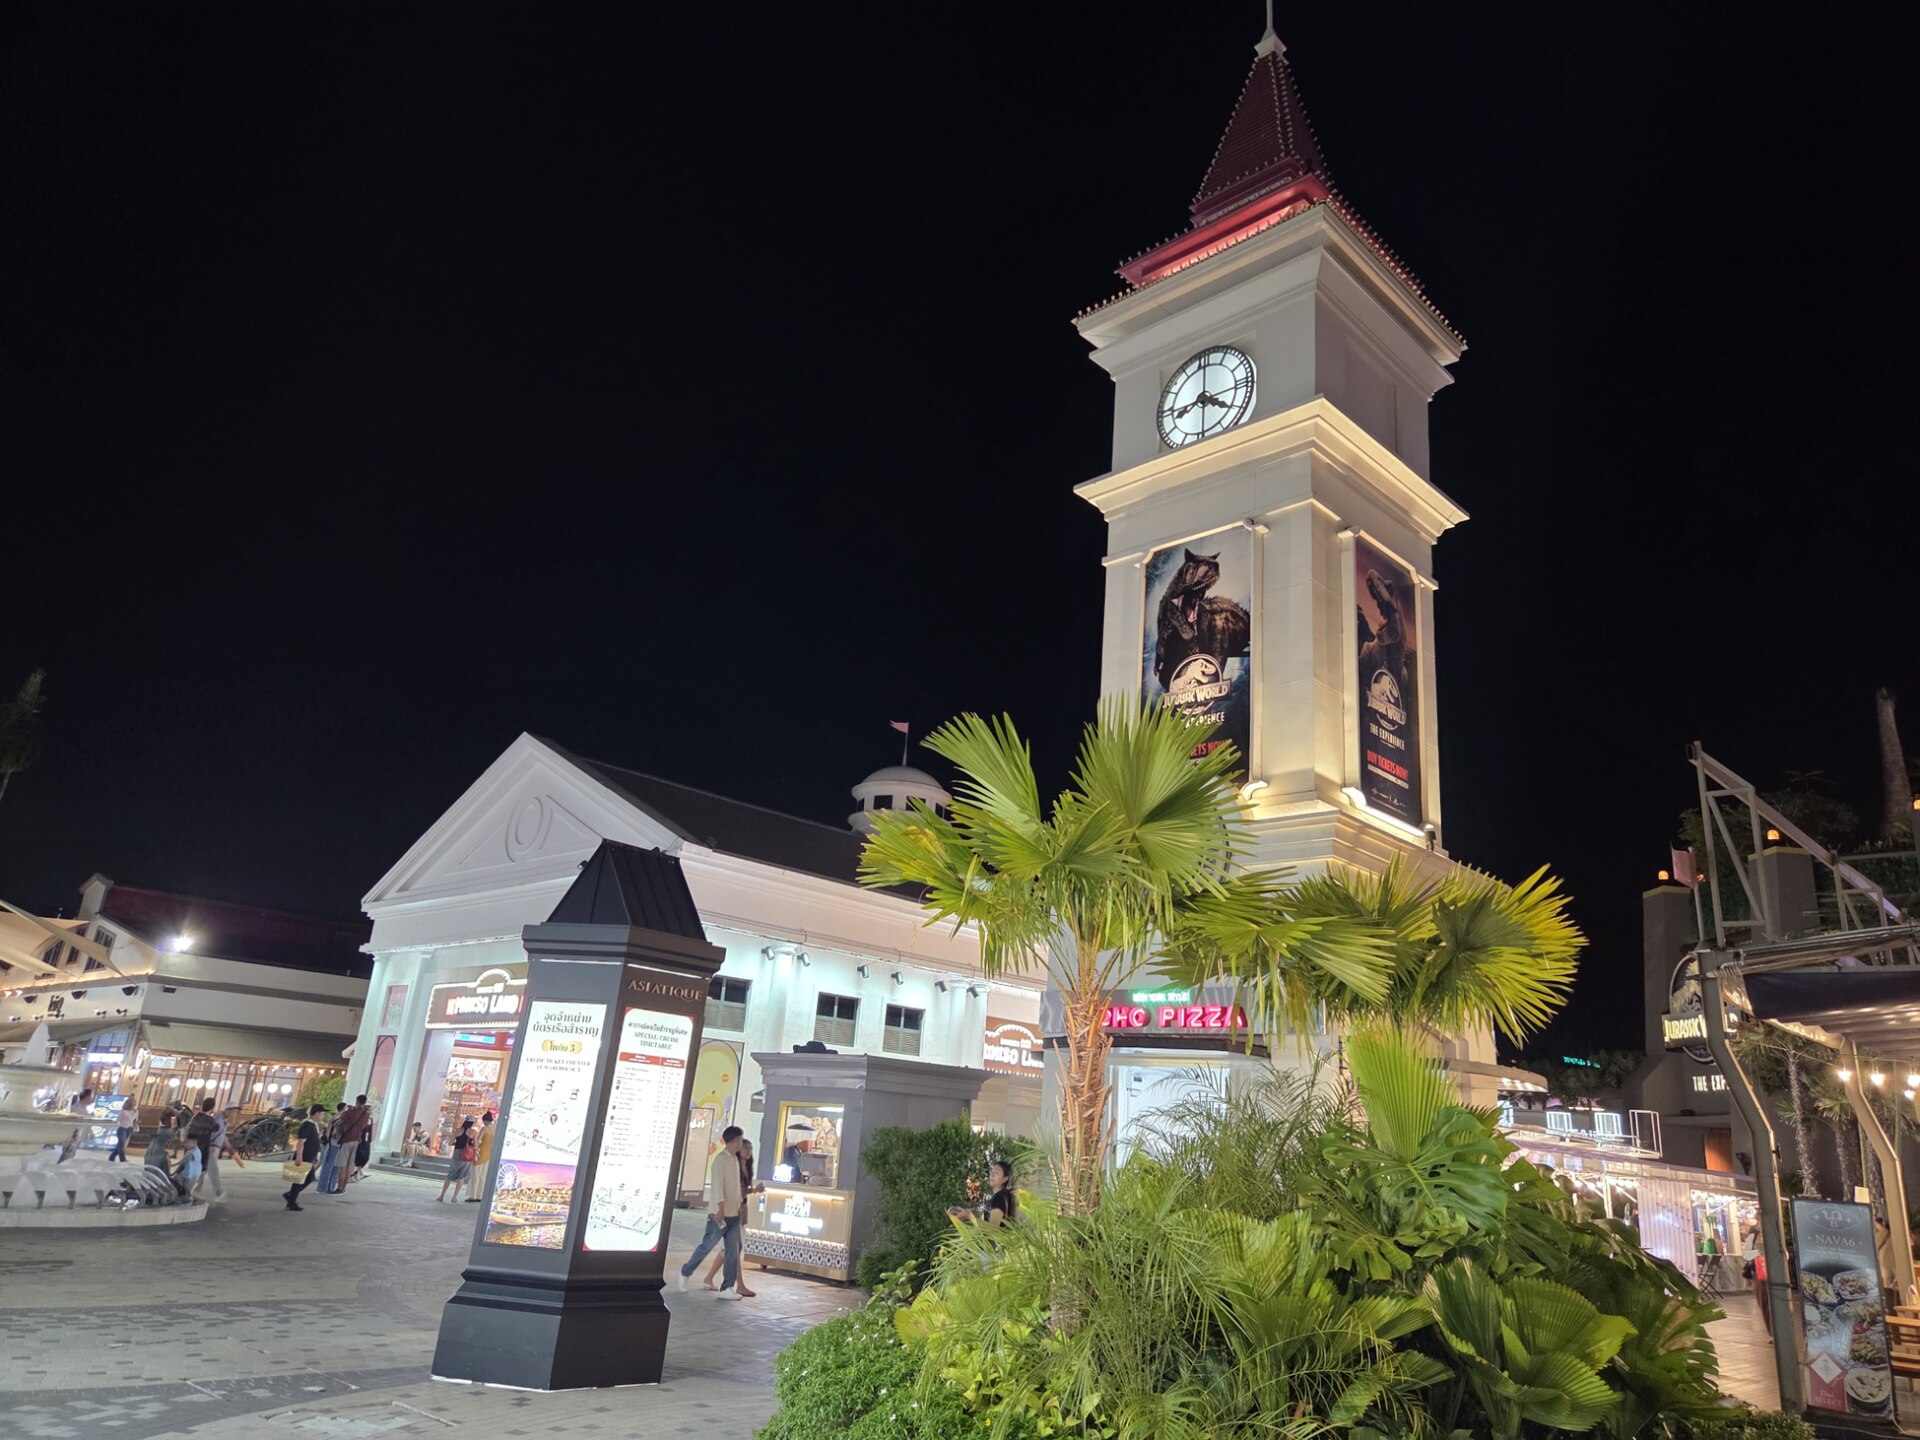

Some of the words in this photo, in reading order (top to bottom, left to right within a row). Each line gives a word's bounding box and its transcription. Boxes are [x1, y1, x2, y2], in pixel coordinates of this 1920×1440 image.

[1196, 685, 1229, 702] WORLD
[1370, 722, 1379, 737] THE
[1379, 727, 1405, 751] EXPERIENCE
[628, 980, 703, 1002] ASIATIQUE
[1158, 1006, 1248, 1028] PIZZA
[634, 1032, 658, 1041] SPECIAL
[659, 1035, 679, 1043] CRUISE
[1664, 1018, 1700, 1042] JURASSIC
[569, 1044, 576, 1053] 3
[640, 1041, 672, 1050] TIMETABLE
[1692, 1075, 1708, 1092] THE
[1815, 1233, 1856, 1248] NAVA6
